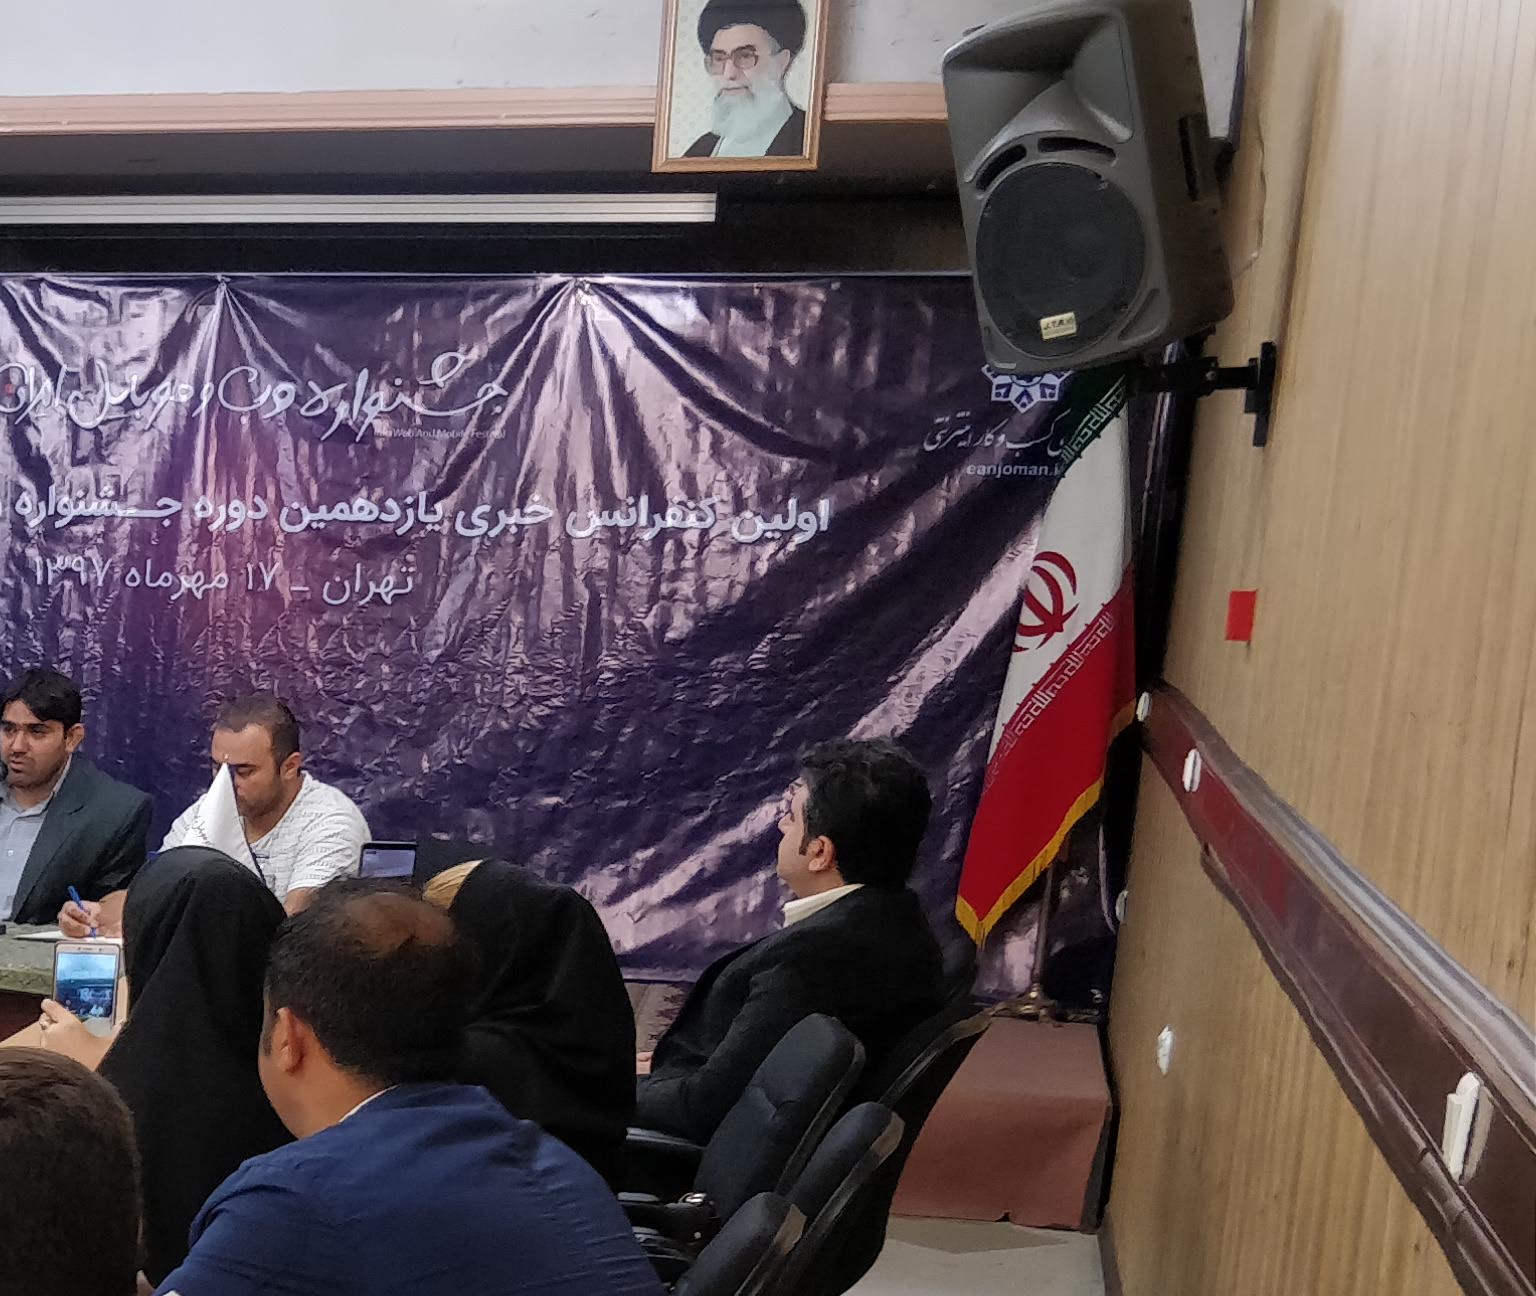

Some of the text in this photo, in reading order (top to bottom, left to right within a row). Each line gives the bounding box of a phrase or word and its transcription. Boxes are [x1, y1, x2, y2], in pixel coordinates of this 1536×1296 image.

[299, 351, 509, 443] جشنواره
[14, 484, 183, 529] جشنواره
[194, 494, 269, 532] دوره
[279, 490, 444, 536] یازدهمین
[455, 493, 555, 537] خبری
[566, 495, 720, 540] کنفرانس
[731, 497, 830, 543] اولین
[34, 555, 112, 587] ۱۳۹۷
[125, 557, 230, 601] مهرماه
[246, 560, 280, 590] ۱۷
[322, 553, 417, 605] تهران
